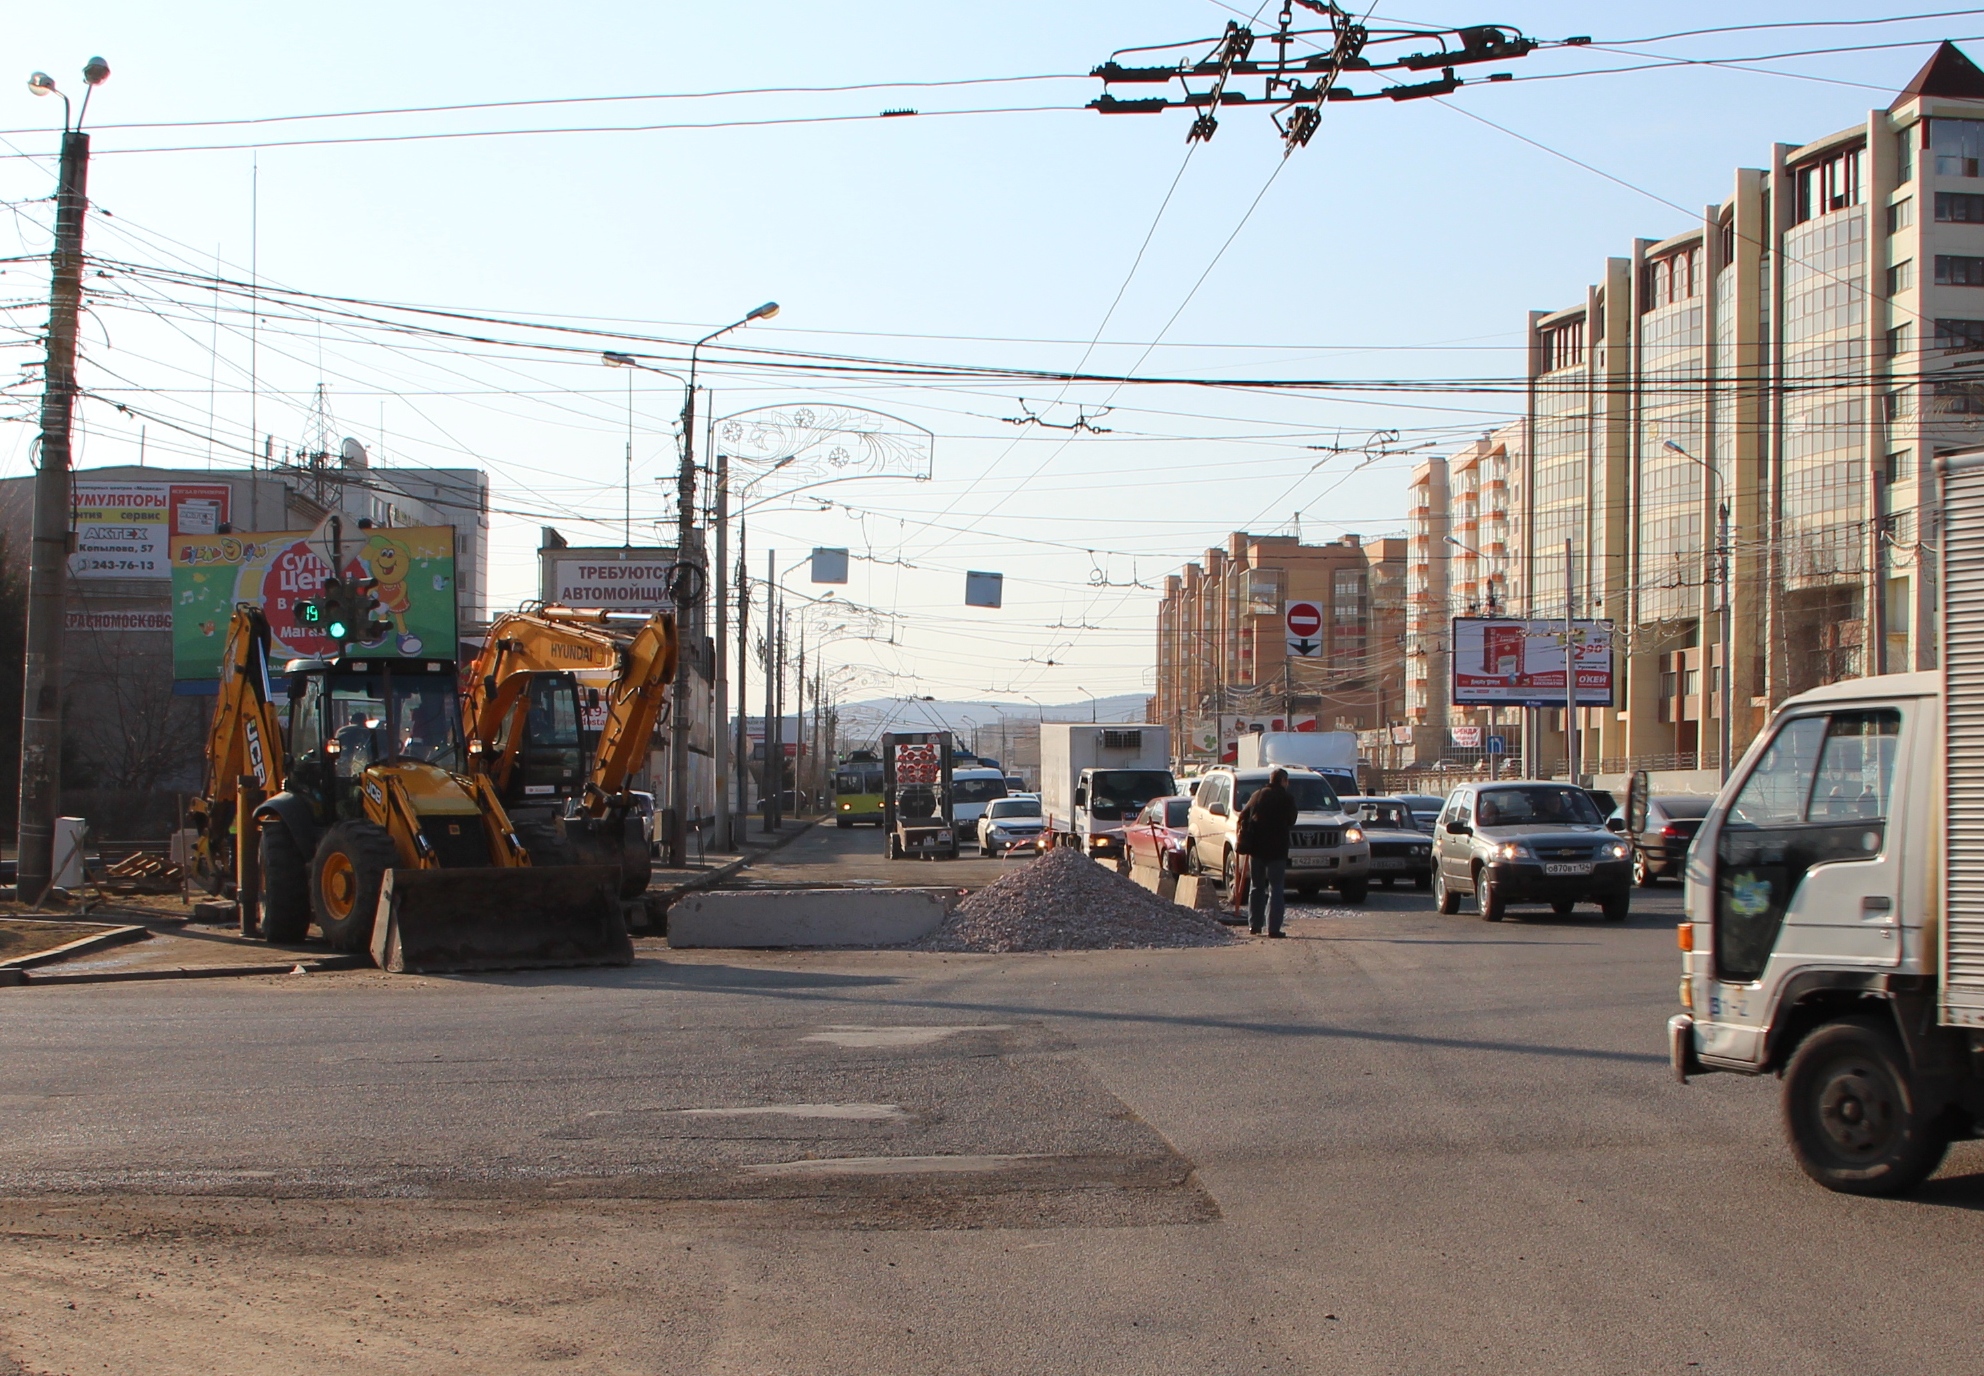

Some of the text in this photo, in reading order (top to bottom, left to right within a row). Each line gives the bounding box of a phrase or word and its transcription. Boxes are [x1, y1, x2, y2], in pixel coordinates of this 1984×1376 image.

[120, 511, 161, 522] сервис
[79, 543, 154, 553] Копылова, 57
[92, 560, 154, 570] 243-76-13
[306, 605, 319, 622] 19
[551, 642, 593, 662] HYUNDAI
[366, 781, 382, 805] JCB
